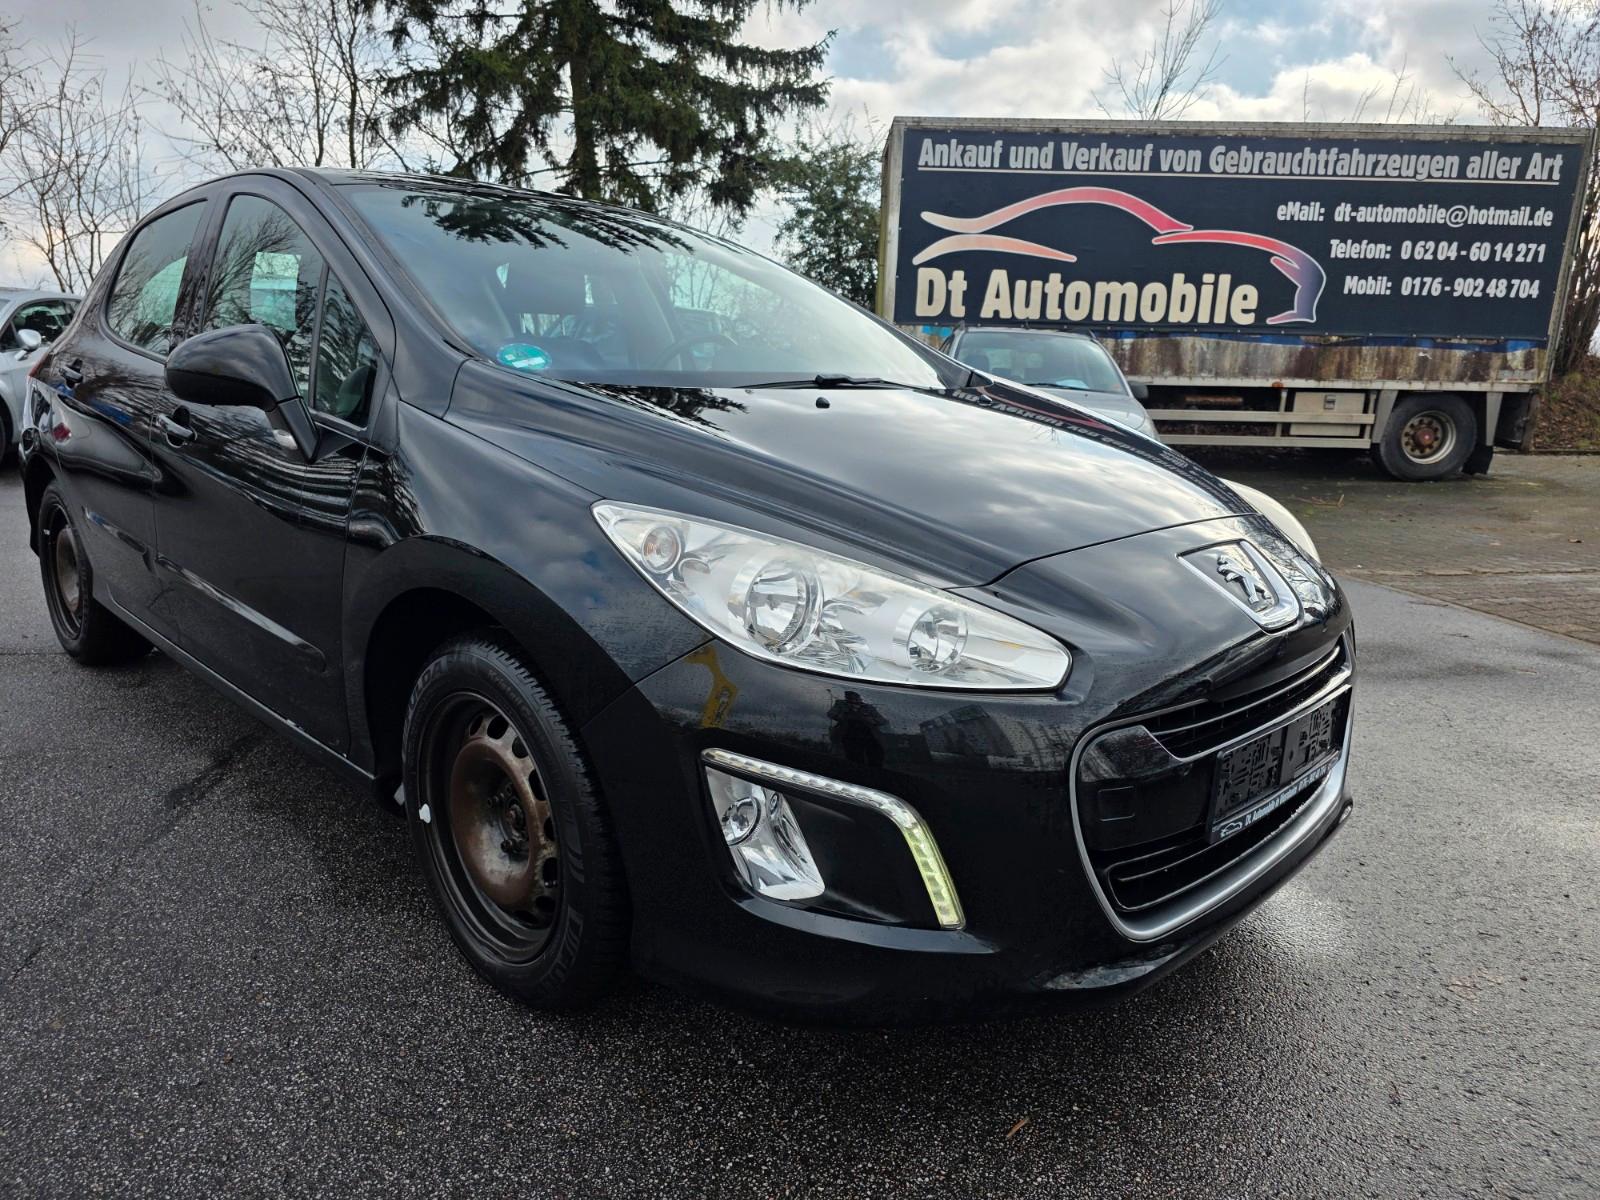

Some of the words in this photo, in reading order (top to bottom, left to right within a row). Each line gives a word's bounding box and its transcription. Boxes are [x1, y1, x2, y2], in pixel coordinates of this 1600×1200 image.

[917, 138, 1003, 167] Ankauf
[1009, 141, 1054, 169] und
[1061, 141, 1154, 172] Verkauf
[1159, 148, 1202, 173] von
[1208, 145, 1460, 180] Gebrauchtfahrzeugen
[1465, 151, 1522, 179] aller
[1525, 152, 1564, 181] Art
[1276, 201, 1326, 222] eMail:
[1333, 202, 1554, 228] dt-automobile@hotmail.de
[1329, 239, 1392, 260] Telefon:
[914, 267, 967, 318] Dt
[980, 268, 1258, 325] Automobile
[1343, 275, 1393, 296] Mobil:
